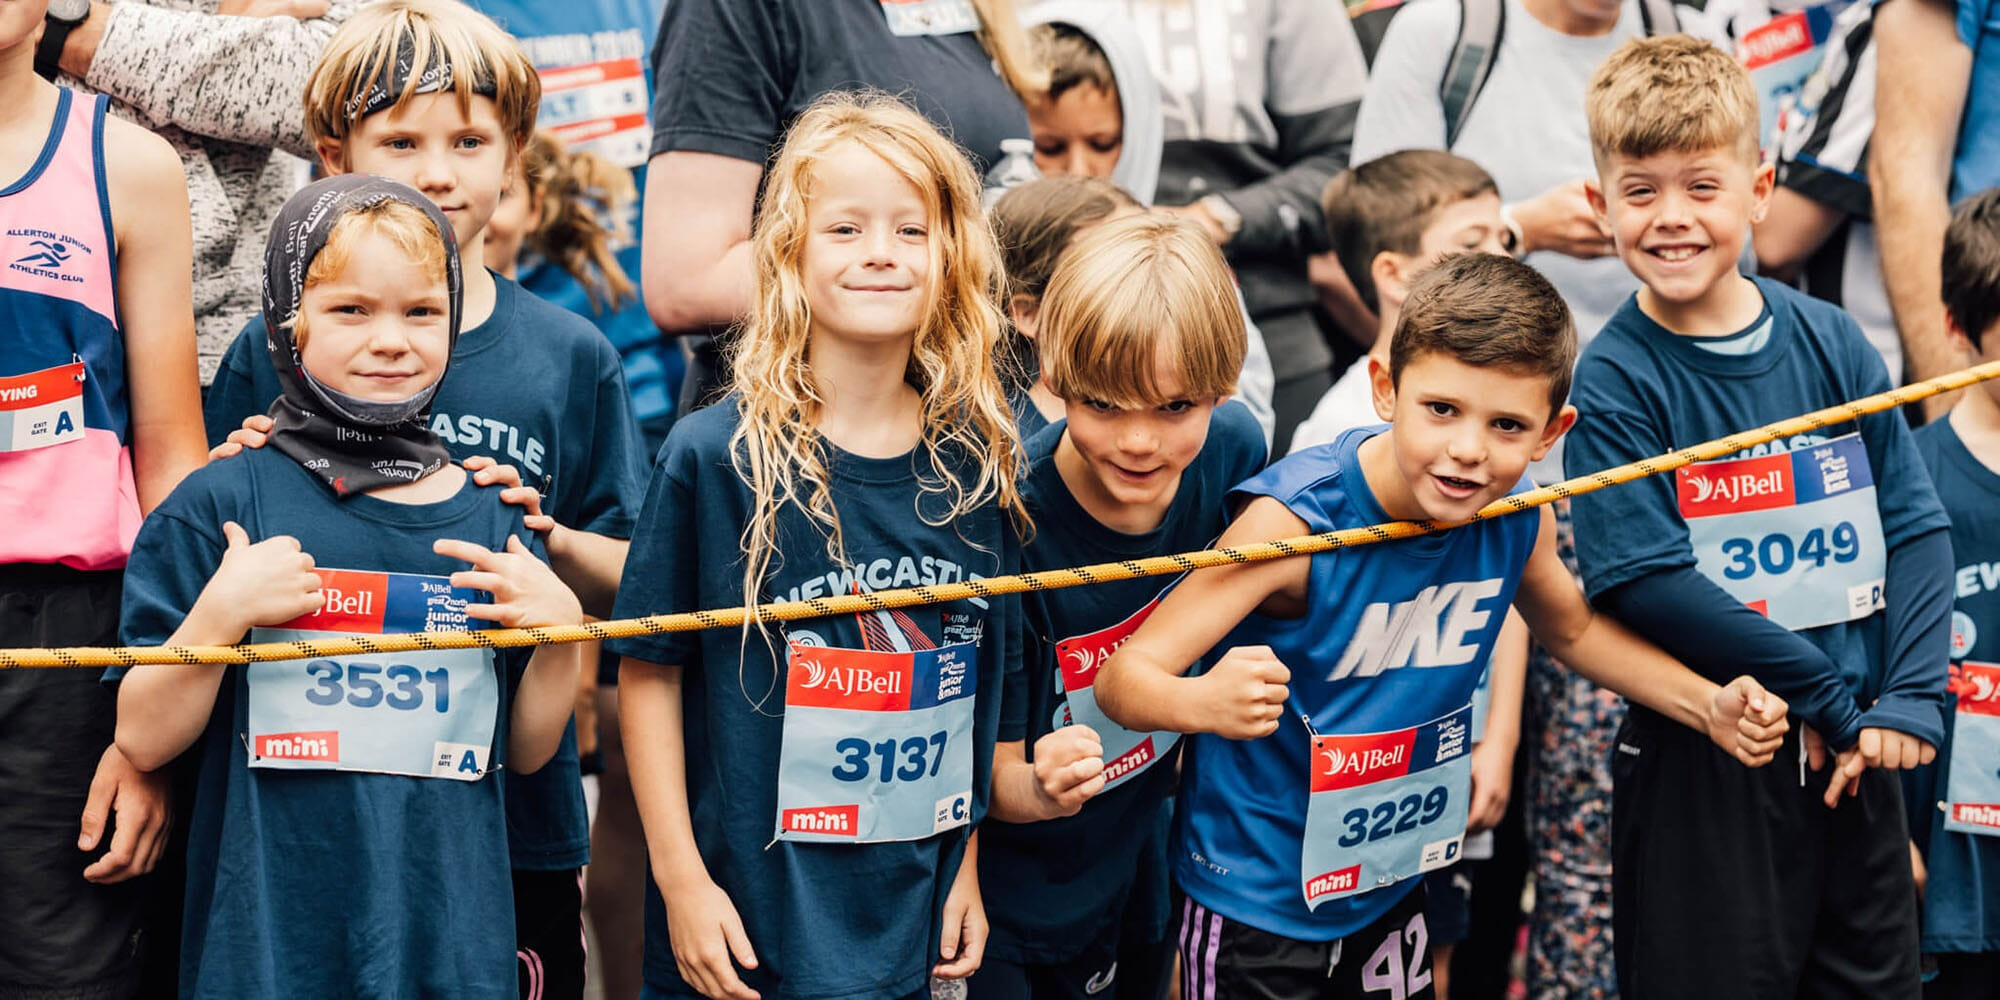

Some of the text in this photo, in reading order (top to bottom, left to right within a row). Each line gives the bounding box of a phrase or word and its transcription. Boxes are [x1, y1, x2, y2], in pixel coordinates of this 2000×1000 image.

[307, 190, 337, 222] north
[6, 229, 92, 254] ALLERTON JUNIOR
[9, 263, 84, 283] ATHLETICS CLUB
[0, 385, 38, 402] YING
[33, 421, 48, 429] EXIT
[54, 410, 74, 435] A
[377, 467, 413, 479] north
[1712, 470, 1784, 503] AJBell
[1721, 521, 1860, 580] 3049
[1871, 585, 1880, 606] D
[425, 608, 469, 622] junior
[305, 659, 450, 714] 3531
[824, 668, 901, 696] AJBell
[265, 737, 328, 757] mini
[831, 730, 948, 783] 3137
[458, 750, 477, 774] A
[1101, 748, 1148, 781] mini
[1343, 744, 1405, 776] AJBell
[791, 811, 849, 830] mini
[952, 797, 965, 821] C
[1338, 785, 1448, 848] 3229
[1445, 841, 1459, 860] D
[1310, 871, 1353, 897] mini
[1362, 912, 1432, 1000] 42
